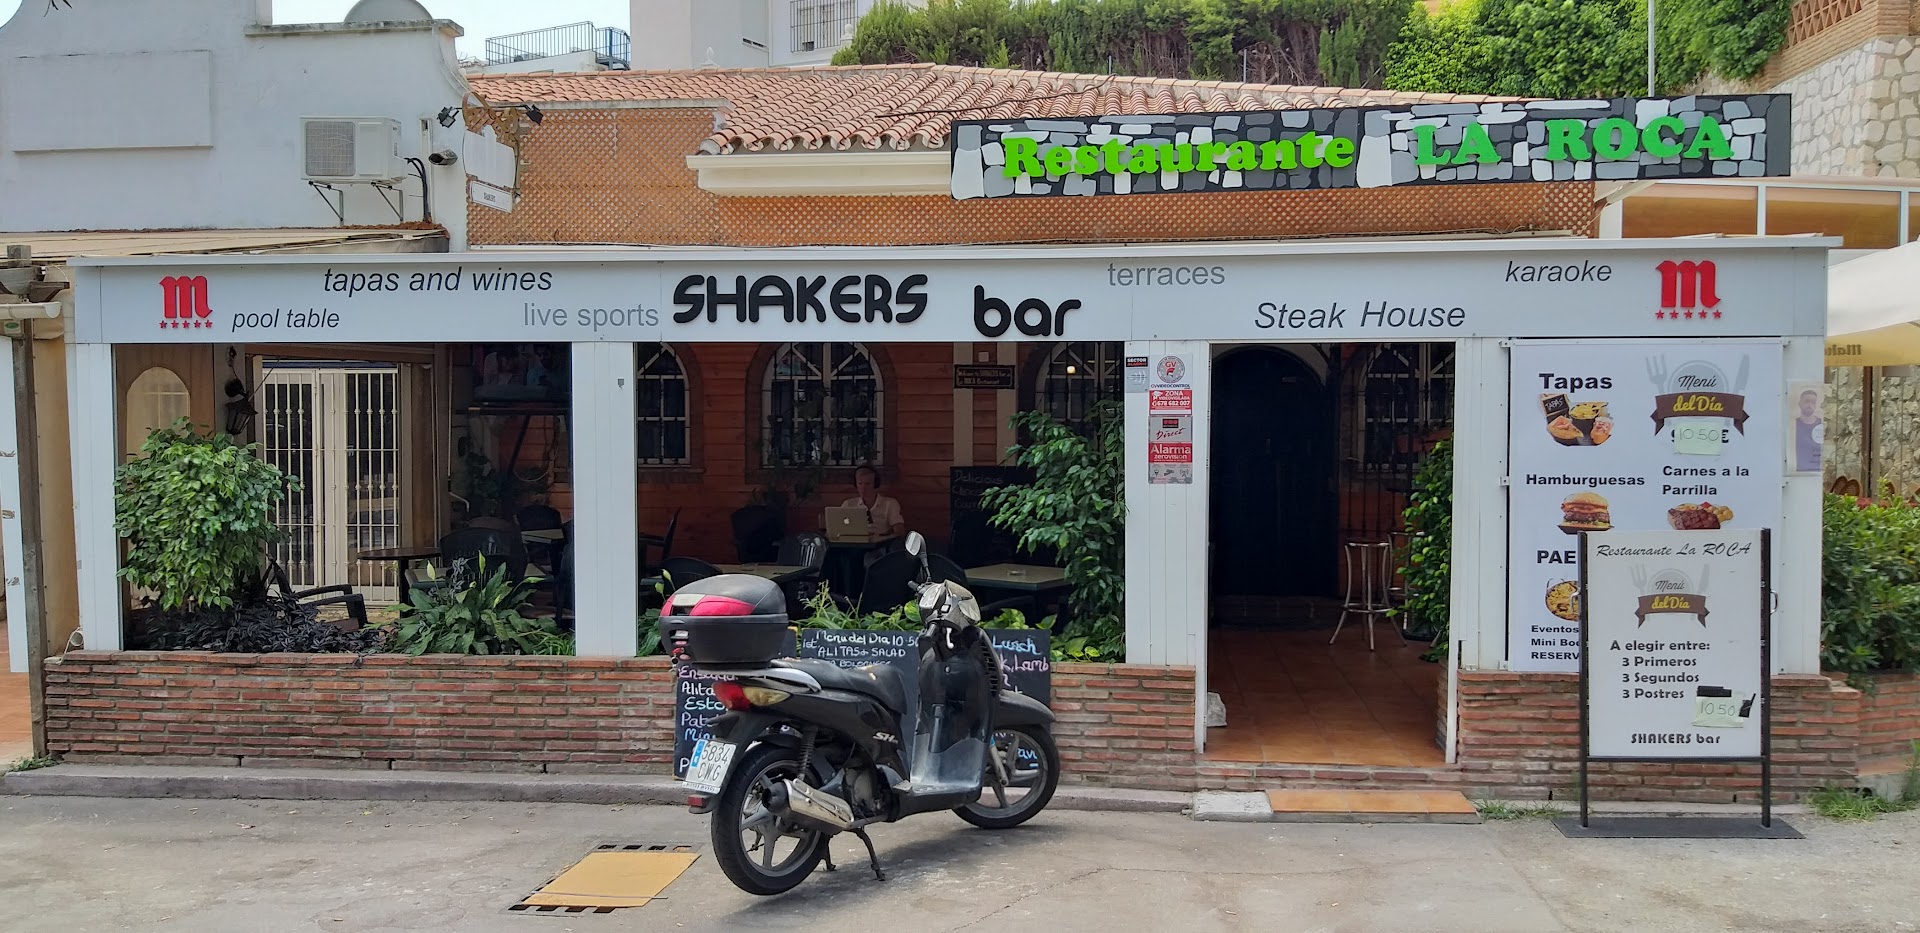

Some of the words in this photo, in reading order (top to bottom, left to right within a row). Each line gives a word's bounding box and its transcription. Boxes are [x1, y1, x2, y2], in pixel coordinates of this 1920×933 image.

[1002, 132, 1355, 178] Restaurante
[1414, 124, 1501, 167] LA
[1546, 117, 1735, 162] ROCA
[1107, 262, 1225, 286] terraces
[1505, 260, 1612, 283] karaoke
[324, 269, 400, 297] tapas
[409, 268, 461, 292] and
[472, 269, 553, 292] wines
[673, 274, 928, 324] SHAKERS
[974, 284, 1082, 338] bar
[232, 308, 280, 332] pool
[286, 308, 340, 330] table
[523, 303, 569, 327] live
[577, 302, 659, 333] sports
[1255, 301, 1346, 329] Steak
[1360, 301, 1465, 329] House
[1539, 373, 1613, 393] Tapas
[1678, 375, 1717, 388] Menú
[1545, 397, 1564, 411] TAPAS
[1673, 396, 1696, 412] del
[1697, 396, 1723, 412] Día
[1156, 428, 1186, 440] Direct
[1150, 444, 1191, 454] Alarma
[1663, 466, 1716, 476] Carnes
[1721, 468, 1731, 476] a
[1736, 466, 1749, 476] la
[1526, 474, 1645, 488] Hamburguesas
[1663, 485, 1717, 495] Parrilla
[1597, 544, 1673, 557] Restaurante
[1676, 542, 1696, 556] La
[1702, 542, 1752, 557] ROCA
[1537, 550, 1576, 564] PAE
[1655, 580, 1685, 591] Menú
[1651, 597, 1668, 610] del
[1669, 597, 1690, 610] Día
[1531, 625, 1579, 633] Eventos
[992, 635, 1042, 655] Lunch
[1531, 638, 1556, 646] Mini
[1610, 640, 1621, 651] A
[1625, 639, 1665, 653] elegir
[1669, 640, 1710, 651] entre:
[871, 647, 906, 658] SALAD
[1622, 657, 1630, 667] 3
[1634, 656, 1697, 667] Primeros
[1622, 673, 1630, 683] 3
[1634, 672, 1700, 684] Segundos
[1622, 689, 1630, 699] 3
[1634, 688, 1684, 699] Postres
[1631, 733, 1692, 744] SHAKERS
[1696, 733, 1721, 744] bar
[701, 745, 731, 765] 5834
[697, 762, 722, 782] CWG
